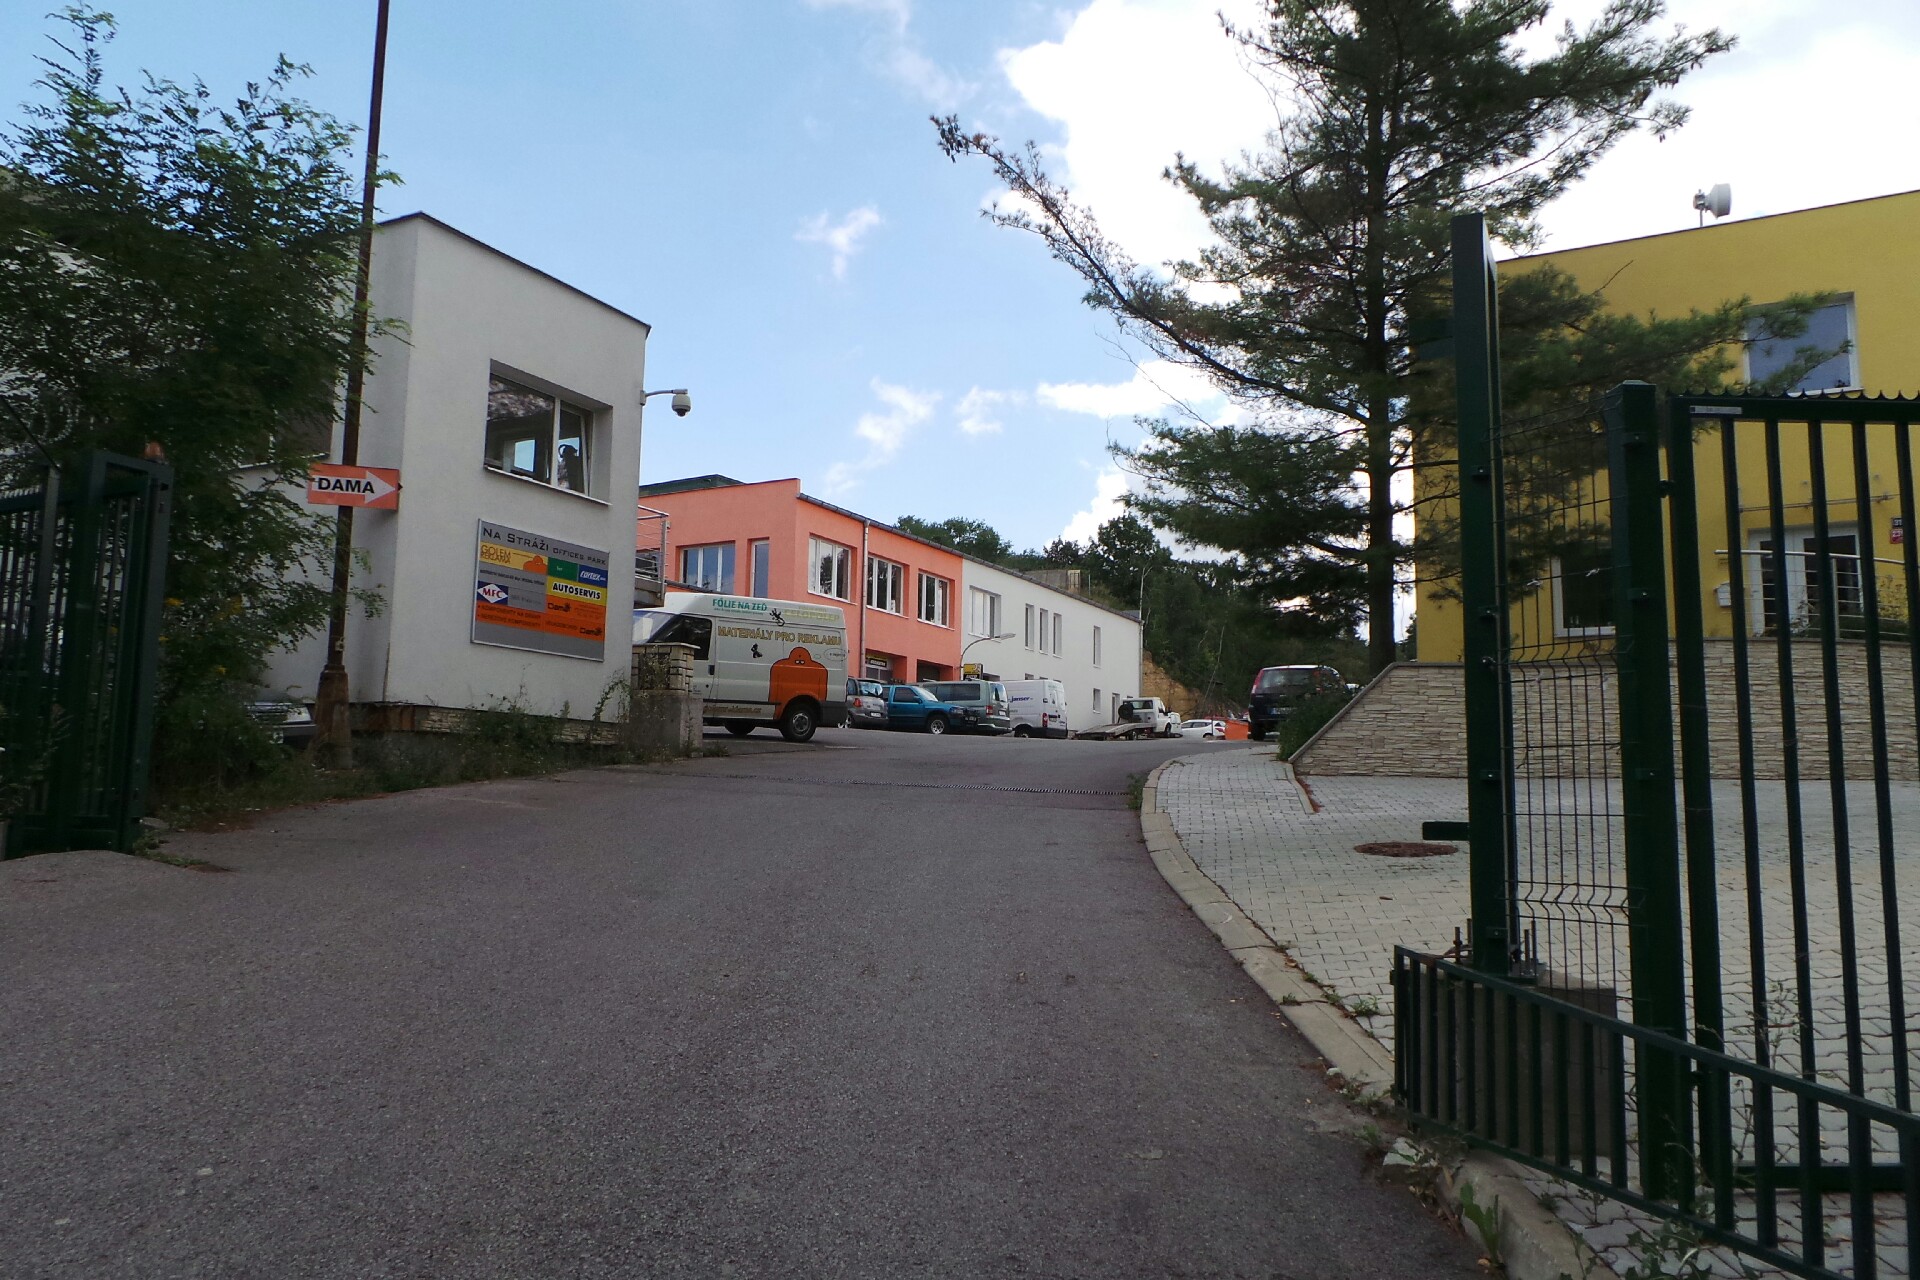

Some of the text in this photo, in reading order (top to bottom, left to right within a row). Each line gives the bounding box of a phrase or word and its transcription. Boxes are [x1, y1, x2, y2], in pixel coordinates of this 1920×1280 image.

[318, 477, 375, 494] DAMA
[481, 545, 511, 558] GOLEM
[483, 527, 606, 566] NA STRÁŽI OFFICES PARK
[482, 588, 503, 599] MFC
[553, 583, 601, 599] AUTOSERVIS
[713, 598, 736, 609] FÓLIE
[738, 601, 750, 610] NA
[752, 602, 767, 612] ZEĎ
[717, 626, 842, 646] MATERIÁLY PRO REKLAMU
